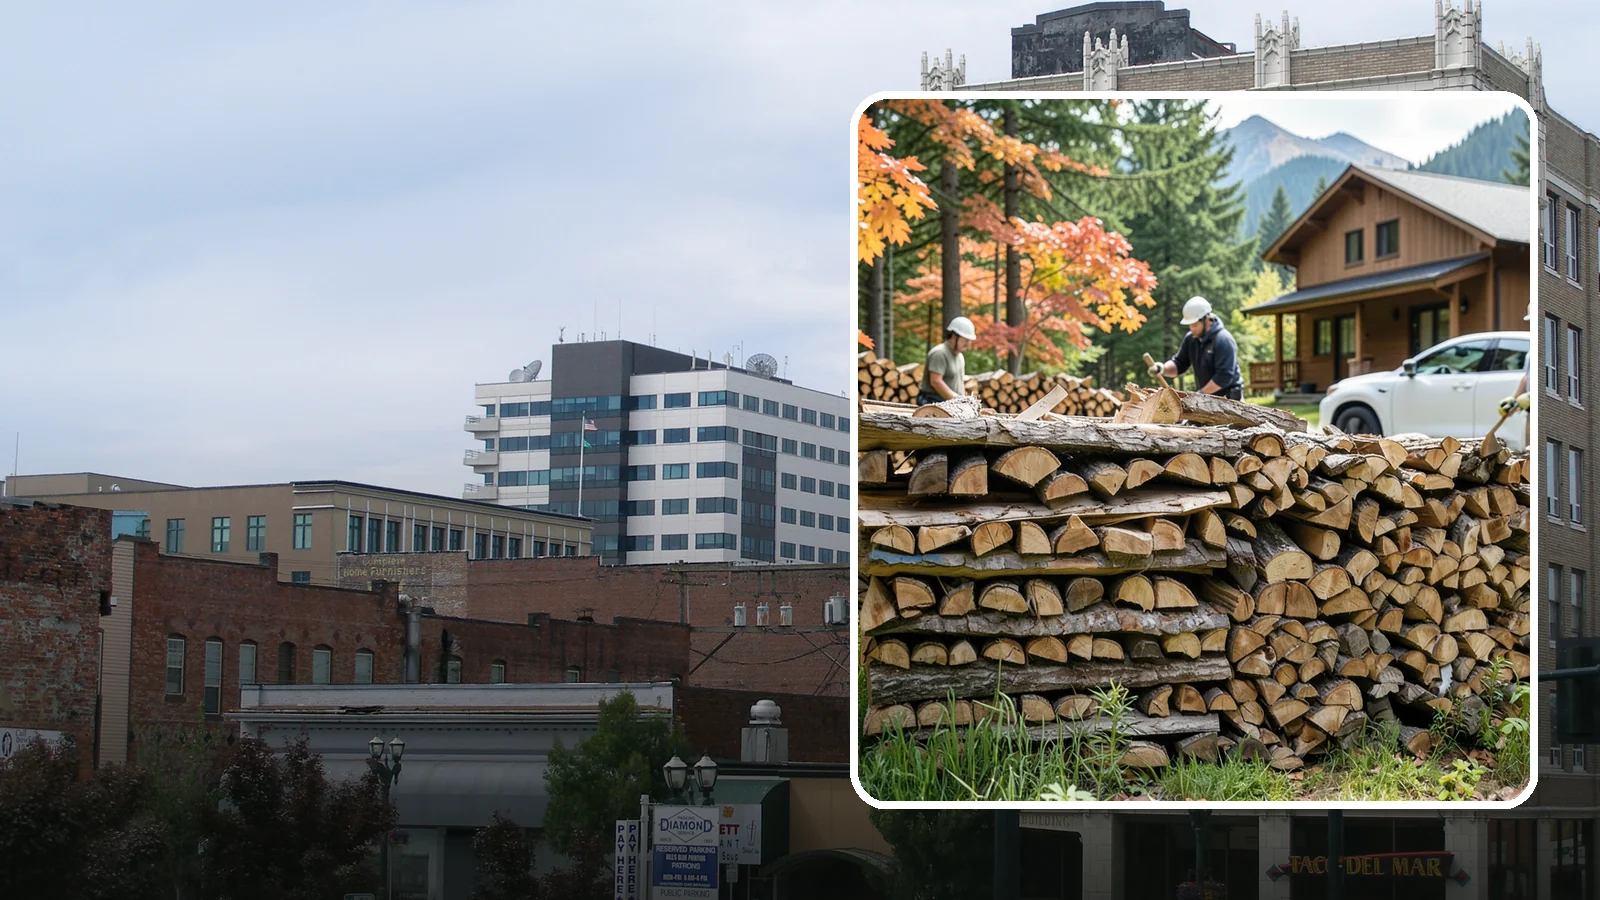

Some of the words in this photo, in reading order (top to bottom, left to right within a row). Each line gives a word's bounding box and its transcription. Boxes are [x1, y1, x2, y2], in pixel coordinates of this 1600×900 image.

[660, 818, 713, 833] DIAMOND
[1022, 815, 1070, 828] BUILDING
[617, 825, 625, 852] PAY
[628, 825, 637, 852] PAY
[656, 845, 688, 853] RESERVED
[689, 846, 716, 854] PARKING
[721, 851, 739, 862] Soup
[671, 862, 701, 870] PATRONS
[1289, 855, 1330, 873] TAC
[1345, 856, 1385, 875] DEL
[1392, 857, 1442, 876] MAR
[616, 856, 625, 894] HERE
[627, 855, 636, 893] HERE
[660, 889, 682, 897] PUBLIC
[683, 889, 710, 898] PARKING
